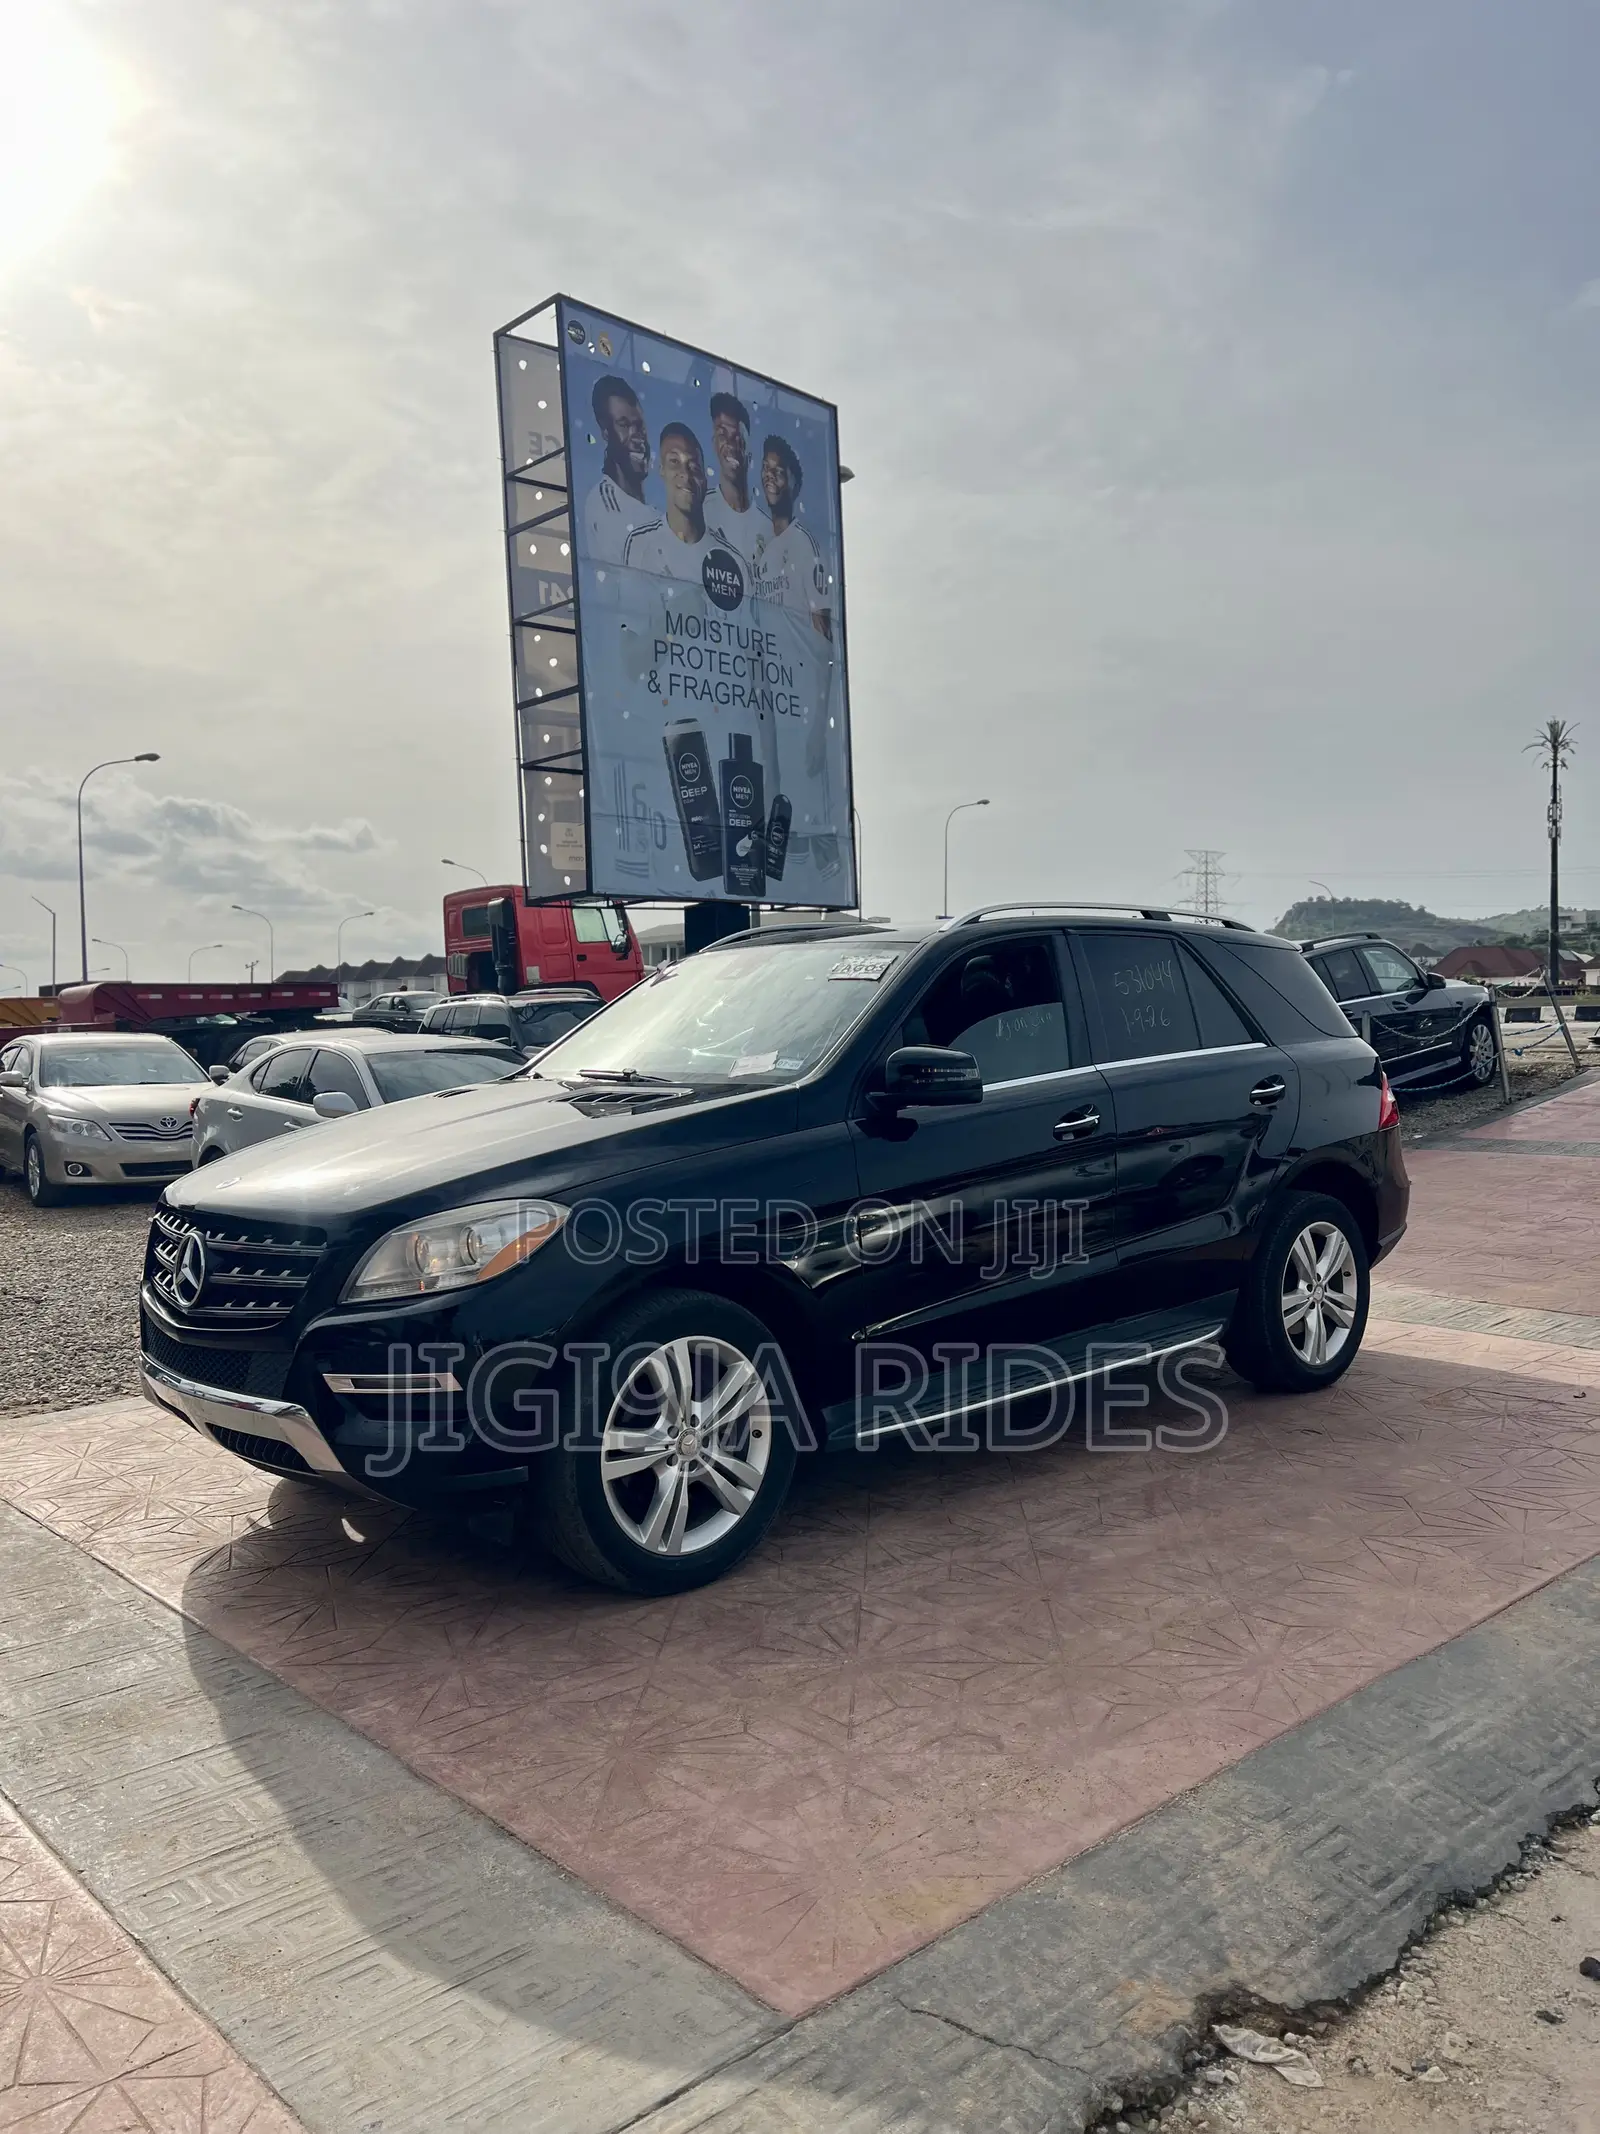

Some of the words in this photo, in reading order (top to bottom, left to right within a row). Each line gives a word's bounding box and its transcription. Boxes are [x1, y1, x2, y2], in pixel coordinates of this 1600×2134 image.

[706, 566, 741, 587] NIVEA
[711, 581, 737, 598] MEN
[665, 610, 783, 661] MOISTURE,
[653, 639, 794, 688] PROTECTION
[647, 669, 662, 695] &
[669, 673, 801, 718] FRAGRANCE
[681, 762, 698, 770] NIVEA
[681, 786, 708, 798] DEEP
[732, 786, 752, 794] NIVEA
[728, 818, 752, 828] DEEP
